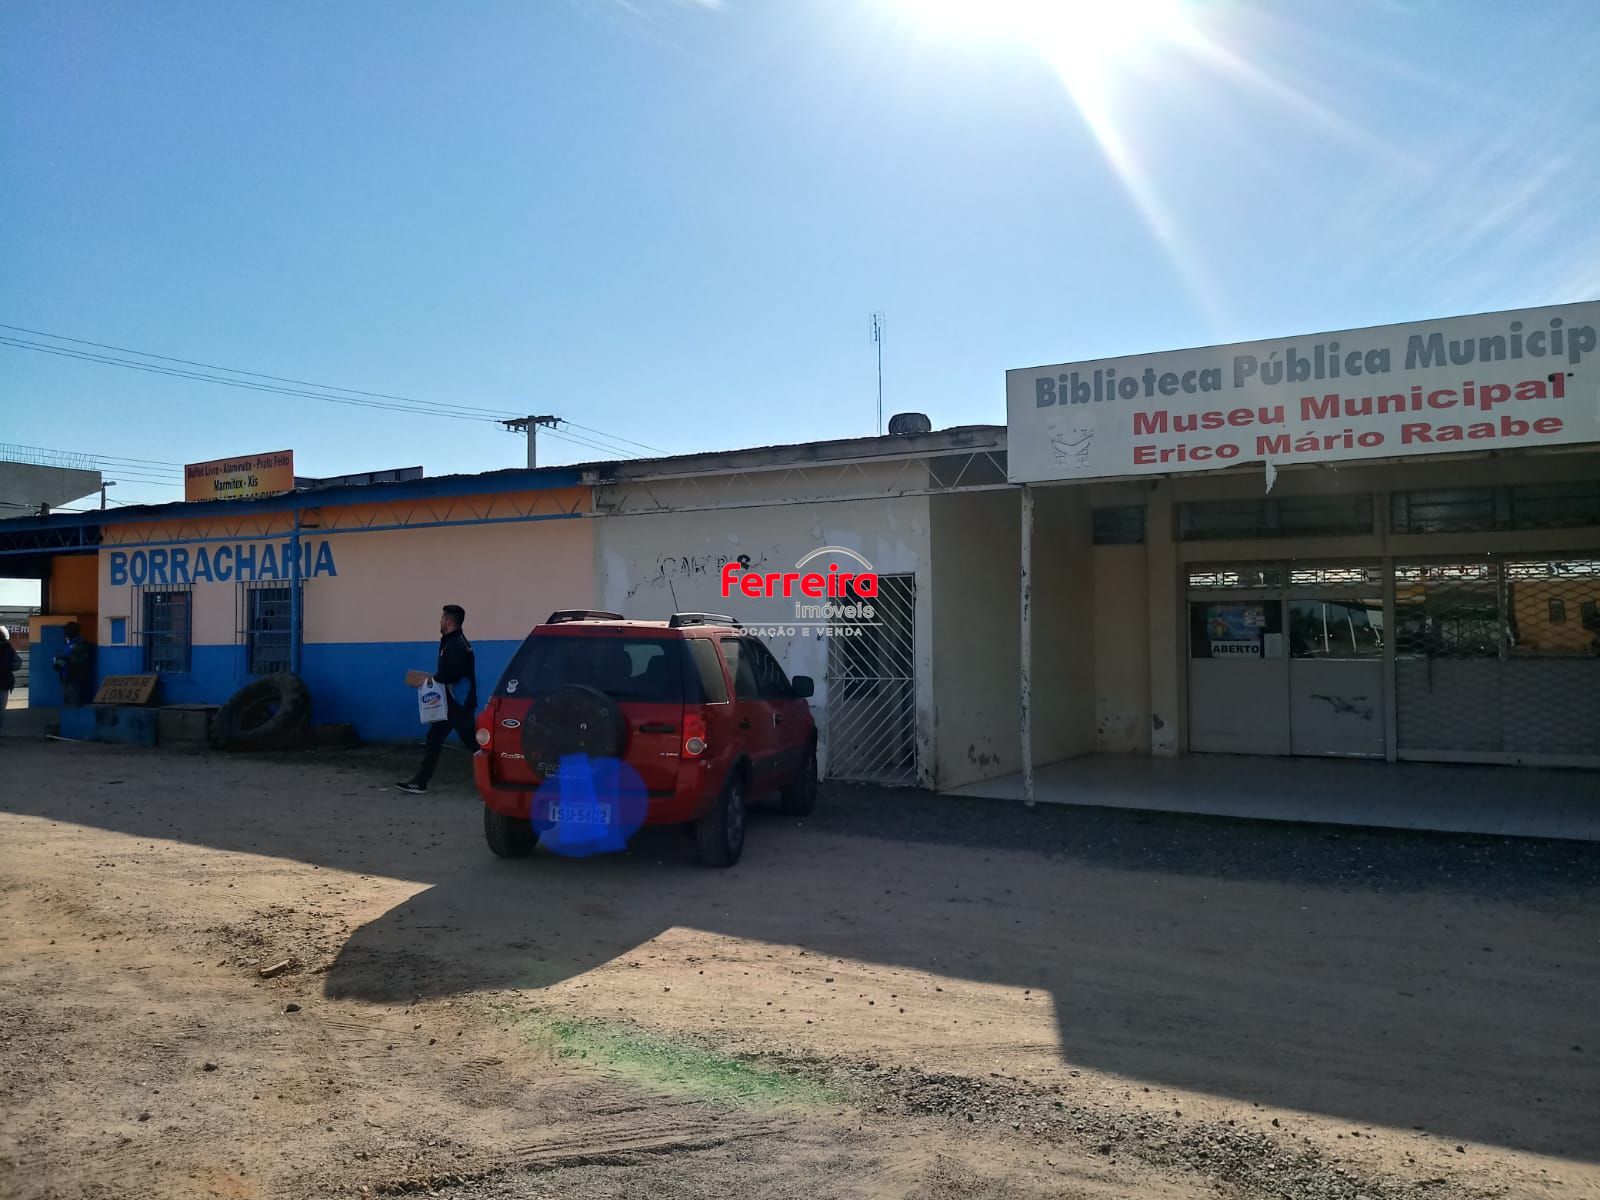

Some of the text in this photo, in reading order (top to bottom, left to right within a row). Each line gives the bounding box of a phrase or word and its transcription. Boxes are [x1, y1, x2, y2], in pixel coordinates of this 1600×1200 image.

[1035, 317, 1597, 409] Biblioteca Pública Municip
[1133, 372, 1565, 435] Museu Municipal
[256, 456, 273, 469] Prato
[274, 455, 290, 466] Feito
[1133, 415, 1564, 465] Erico Mário Raabe
[214, 475, 259, 491] Marmitex Xis
[110, 541, 338, 586] BORRACHARIA
[1213, 644, 1259, 654] ABERTO
